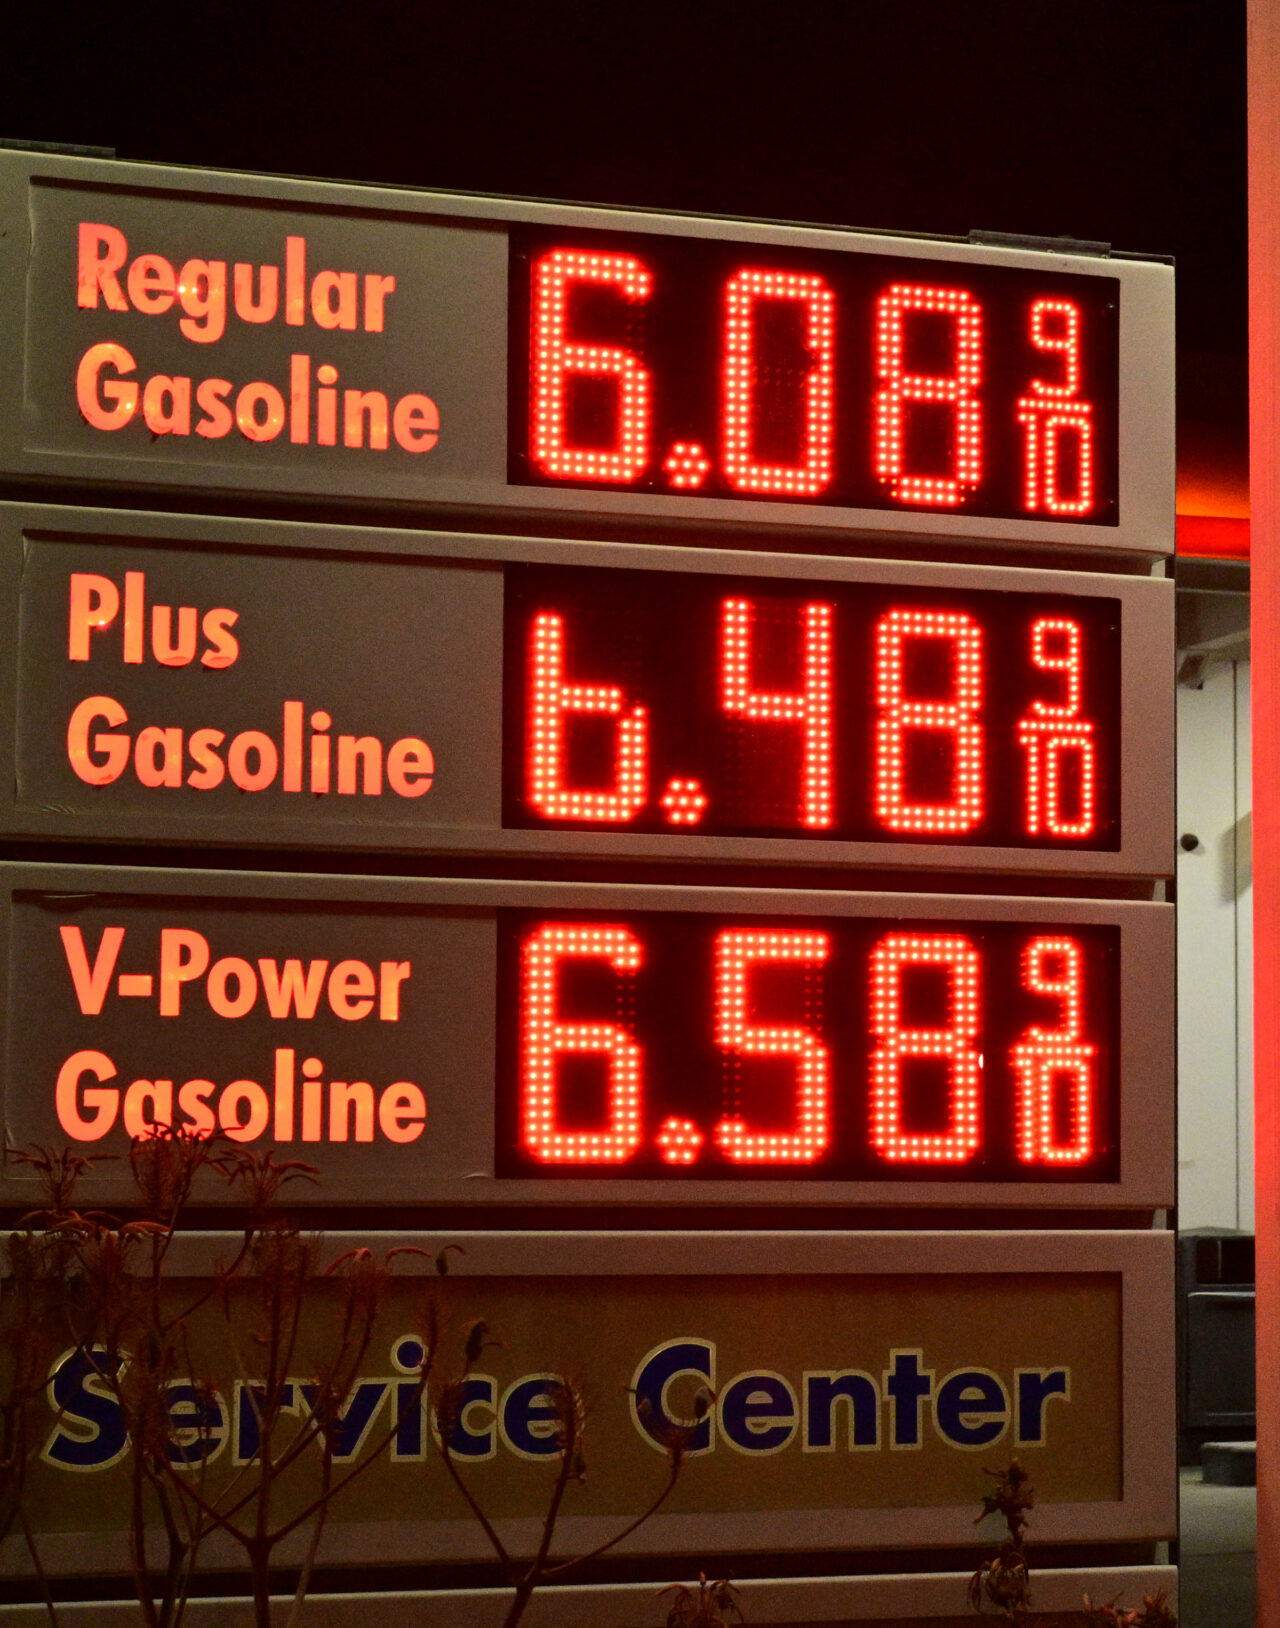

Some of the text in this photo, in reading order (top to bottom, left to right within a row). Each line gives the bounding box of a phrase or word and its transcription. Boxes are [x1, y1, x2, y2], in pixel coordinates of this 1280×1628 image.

[77, 222, 396, 343] Regular
[76, 343, 441, 453] Gasoline
[533, 248, 983, 506] 6.08
[69, 571, 240, 669] Plus
[67, 695, 435, 798] Gasoline
[59, 925, 411, 1022] V-Power
[55, 1048, 427, 1143] Gasoline
[524, 921, 981, 1165] 6.58
[41, 1334, 1071, 1472] Service Center
